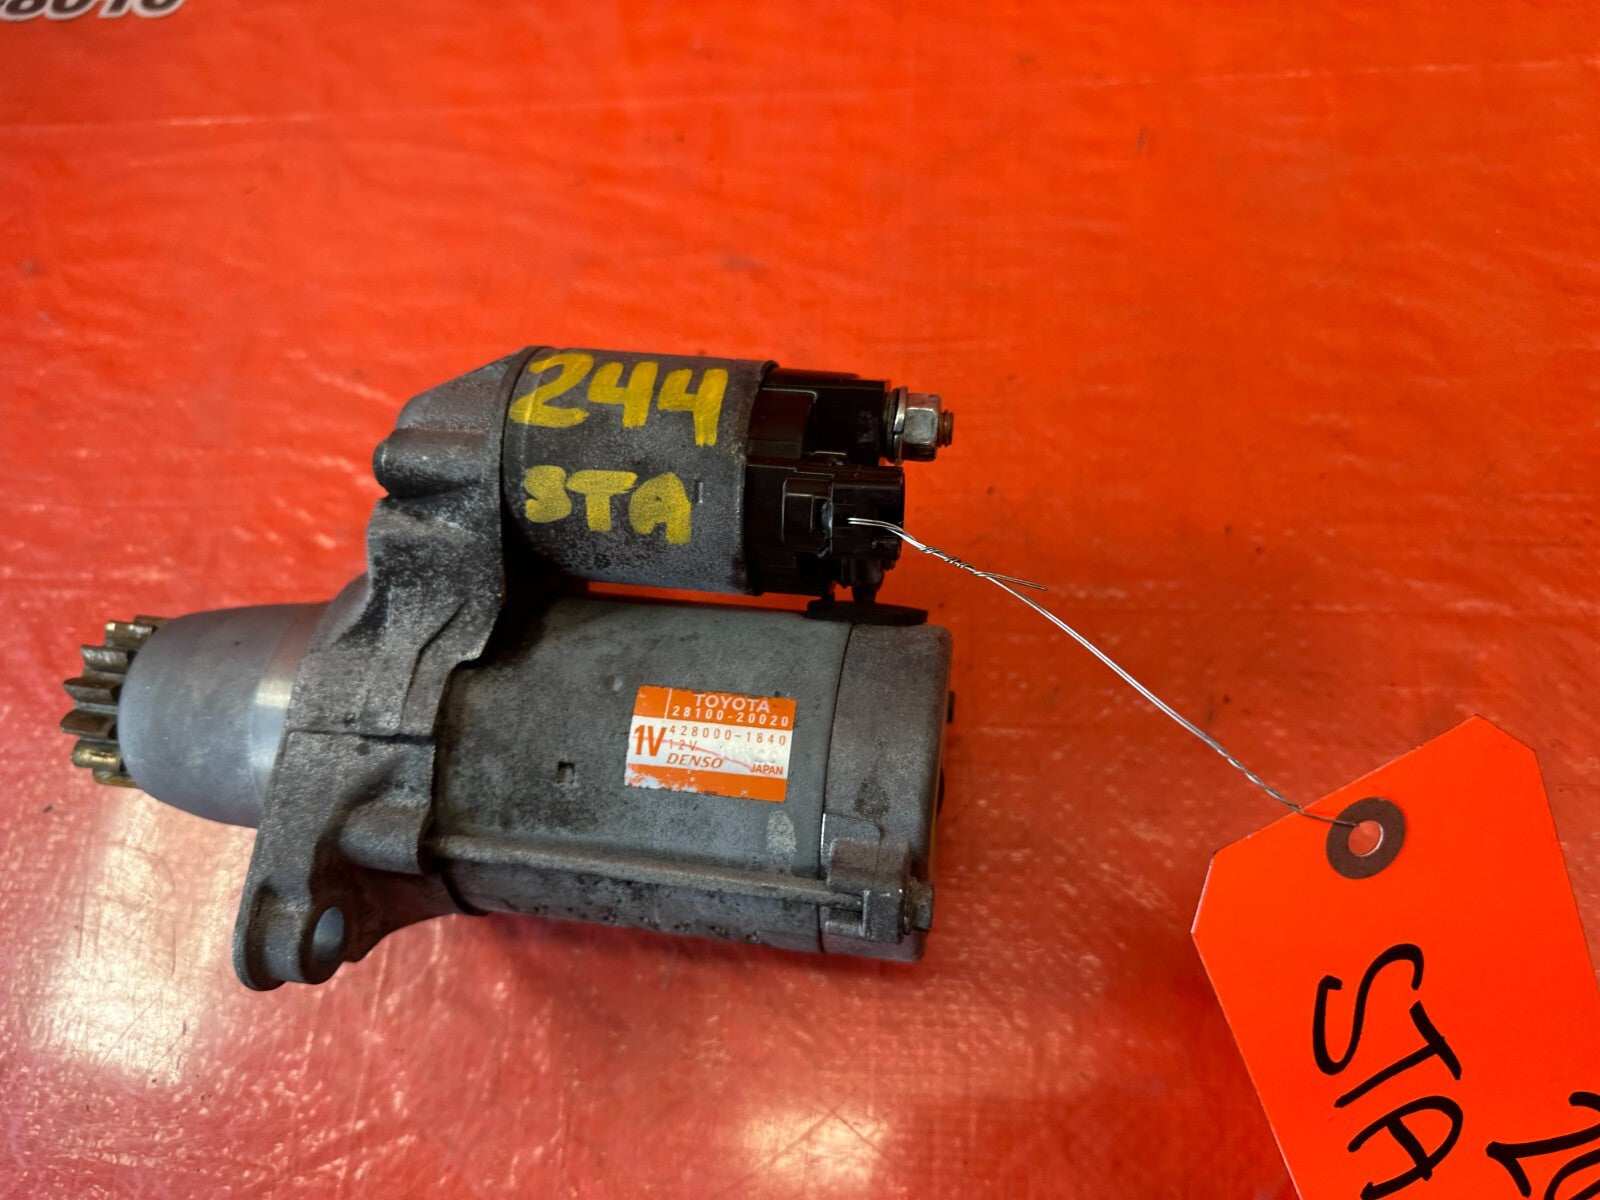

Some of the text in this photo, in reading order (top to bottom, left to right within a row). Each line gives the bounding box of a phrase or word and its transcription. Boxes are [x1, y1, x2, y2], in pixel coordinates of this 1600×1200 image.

[509, 353, 728, 446] 244
[523, 465, 692, 545] STA
[693, 693, 771, 713] TOYOTA
[672, 705, 789, 727] 28100-20020
[633, 724, 667, 757] 1V
[669, 725, 787, 746] 428000-1840
[666, 752, 723, 769] DENSO
[750, 763, 784, 776] JAPAN
[1312, 943, 1463, 1200] STA
